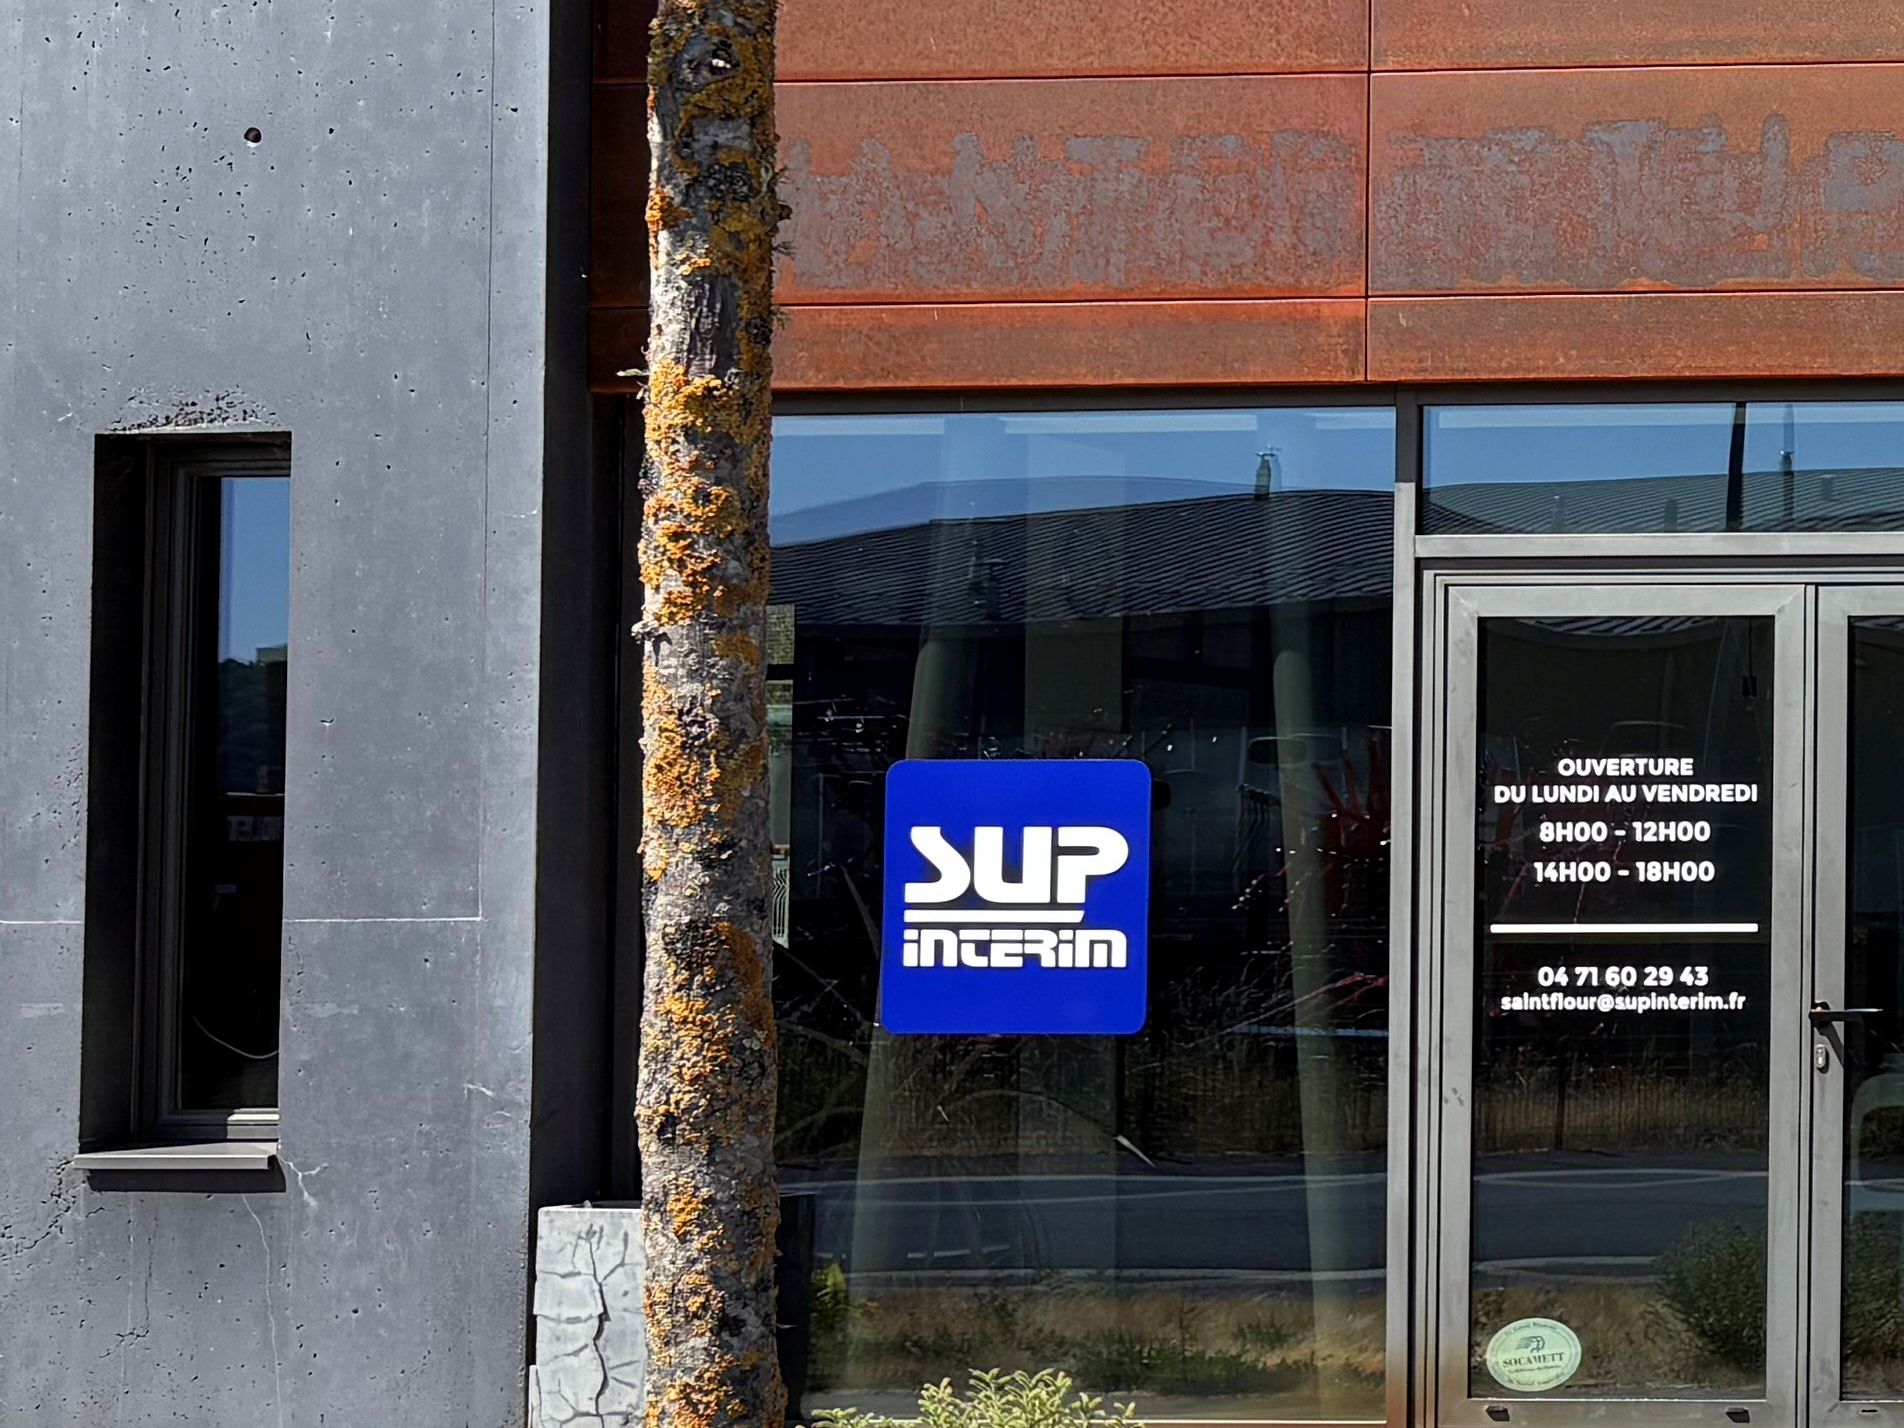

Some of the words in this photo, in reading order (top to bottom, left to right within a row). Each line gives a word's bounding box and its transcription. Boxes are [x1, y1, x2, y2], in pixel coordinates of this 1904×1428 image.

[1557, 758, 1694, 776] OUVERTURE
[1494, 785, 1526, 803] DU
[1531, 785, 1600, 803] LUNDI
[1604, 785, 1637, 803] AU
[1641, 783, 1758, 802] VENDREDI
[1539, 821, 1608, 842] 8H00
[1631, 821, 1711, 842] 12H00
[904, 825, 1129, 903] SUP
[1533, 861, 1611, 882] 14H00
[1635, 861, 1716, 882] 18H00
[1537, 966, 1569, 987] 04
[1574, 966, 1599, 987] 71
[1604, 966, 1637, 987] 60
[1643, 966, 1674, 987] 29
[1679, 966, 1709, 987] 43
[1500, 991, 1747, 1014] saintflour@supinterim.fr
